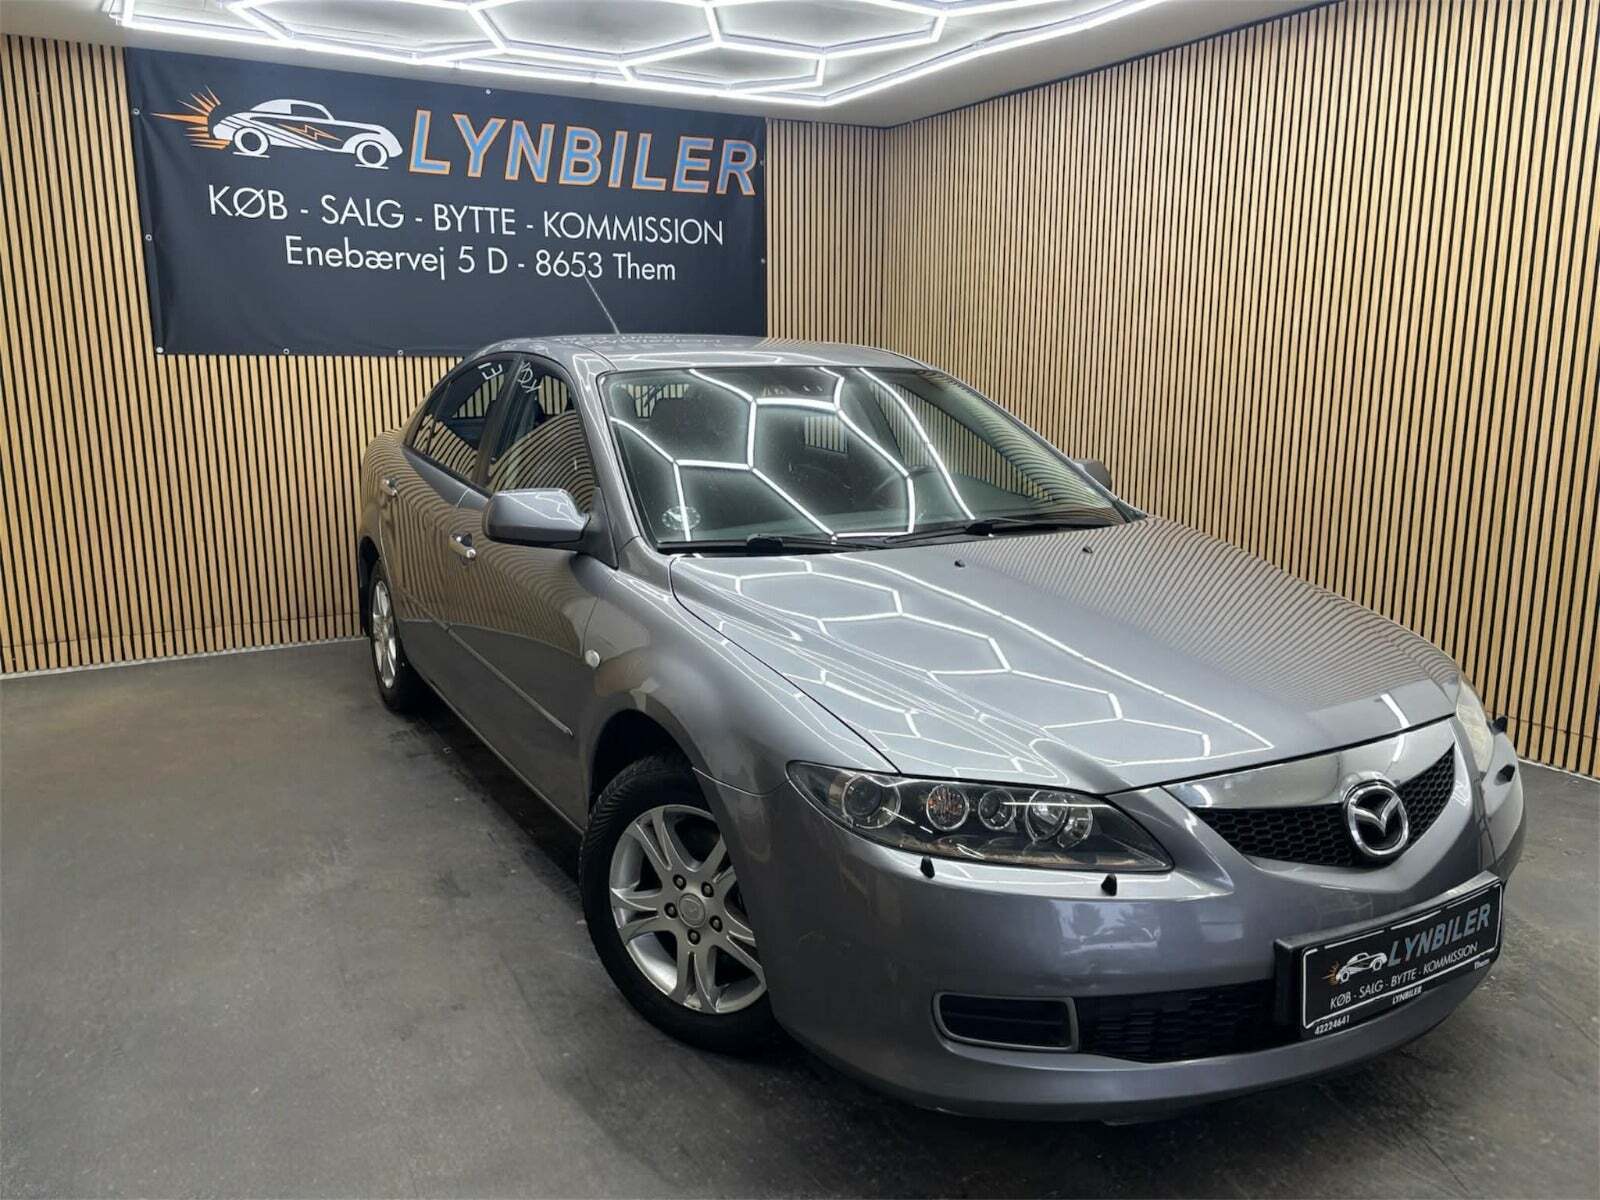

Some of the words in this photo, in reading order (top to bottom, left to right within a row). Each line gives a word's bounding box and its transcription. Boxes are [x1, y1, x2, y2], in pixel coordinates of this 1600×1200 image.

[408, 109, 757, 196] LYNBILER
[208, 184, 287, 220] KØB
[321, 195, 405, 229] SALG
[434, 204, 516, 235] BYTTE
[544, 211, 724, 246] KOMMISSION
[285, 236, 445, 280] Enebærvej
[459, 245, 475, 273] 5
[489, 248, 508, 275] D
[536, 250, 603, 278] 8653
[613, 253, 676, 281] Them
[1388, 903, 1491, 967] LYNBILER
[1330, 992, 1351, 1009] KØB
[1359, 979, 1384, 996] SALG
[1391, 968, 1417, 987] BYTTE
[1423, 942, 1478, 974] KOMMISSION
[1392, 986, 1422, 1005] LYNBILER
